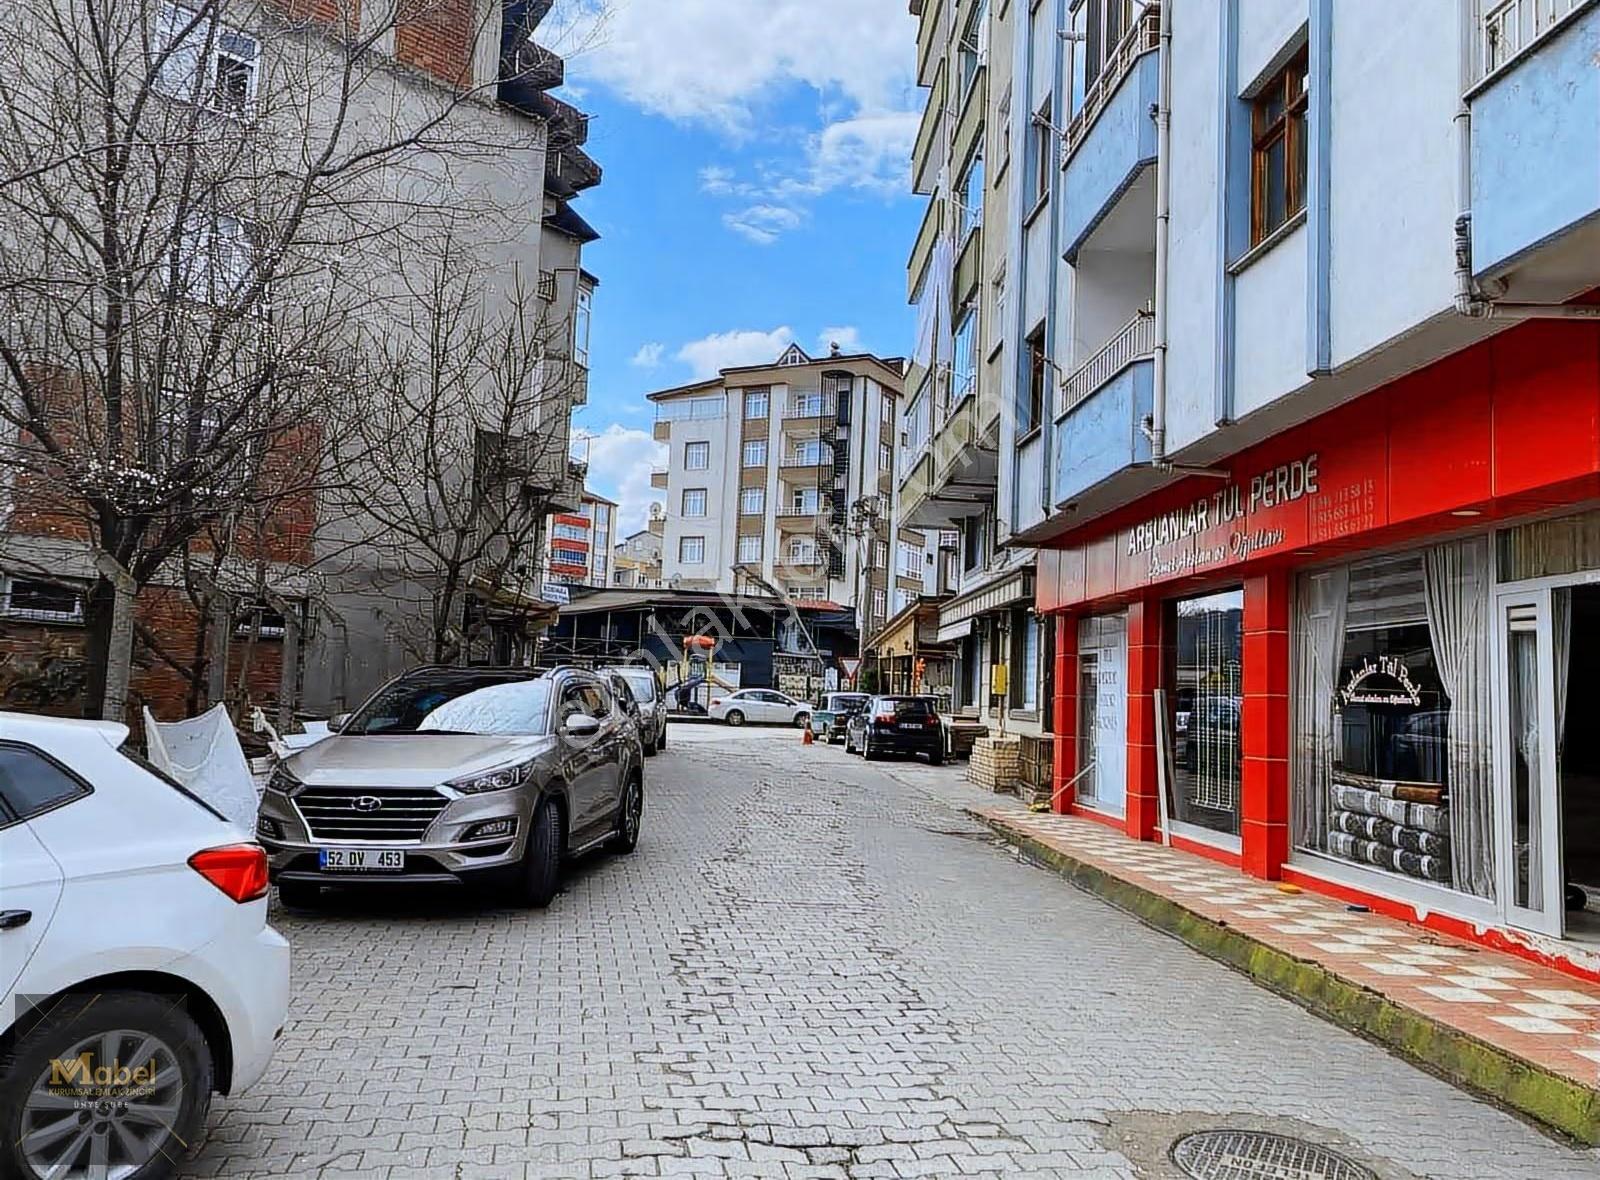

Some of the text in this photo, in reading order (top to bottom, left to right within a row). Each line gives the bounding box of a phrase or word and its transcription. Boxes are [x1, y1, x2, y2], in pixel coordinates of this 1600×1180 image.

[1251, 454, 1318, 513] PERDE
[328, 852, 344, 866] 52
[378, 852, 401, 866] 453
